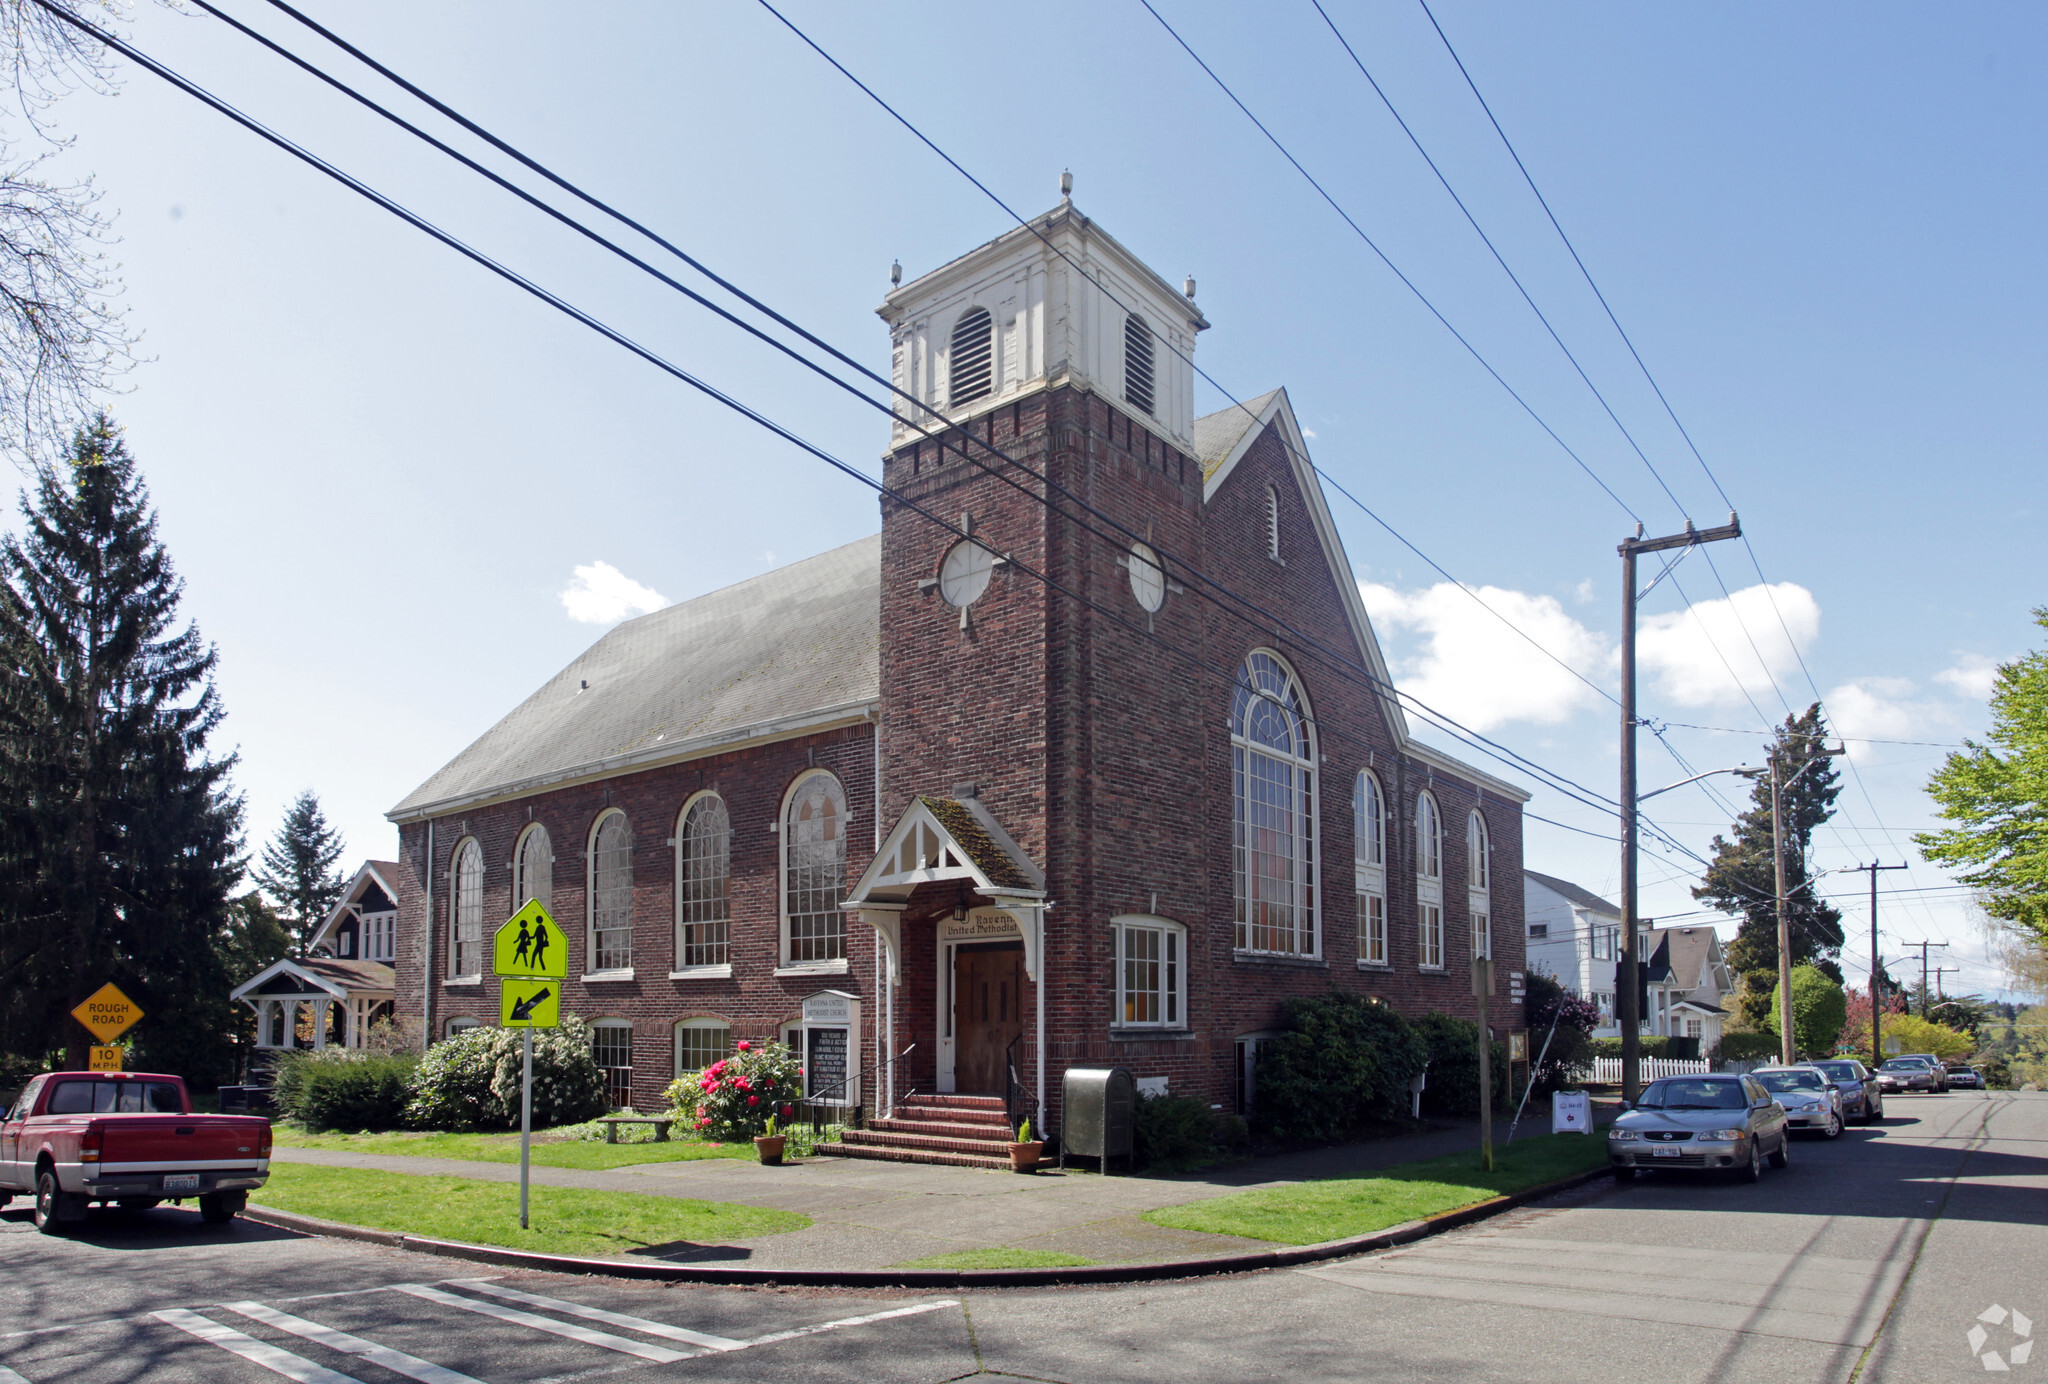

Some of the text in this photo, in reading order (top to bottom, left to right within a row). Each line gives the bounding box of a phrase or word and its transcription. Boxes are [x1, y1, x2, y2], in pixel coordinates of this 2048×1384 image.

[975, 915, 1015, 925] Ravenn
[947, 923, 1017, 935] United Methodist
[89, 1003, 129, 1013] ROUGH
[92, 1015, 124, 1024] ROAD
[98, 1050, 114, 1060] 10
